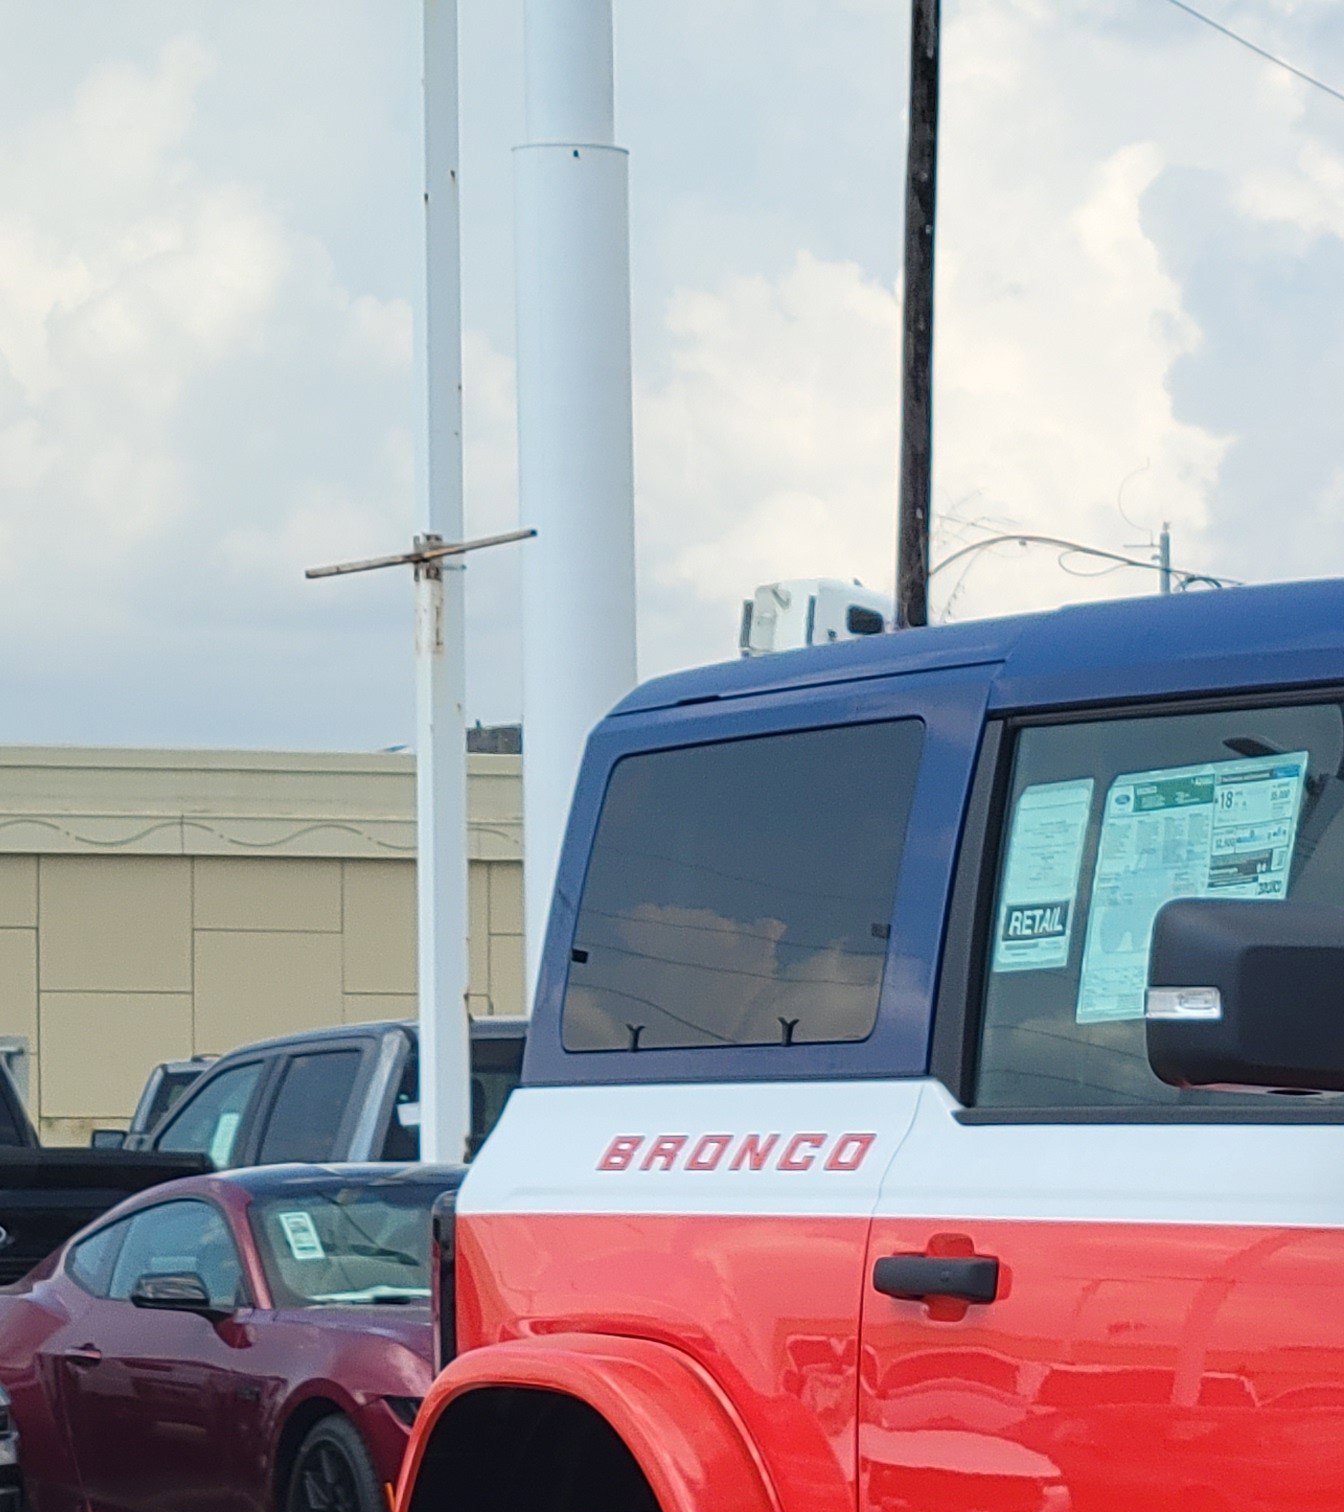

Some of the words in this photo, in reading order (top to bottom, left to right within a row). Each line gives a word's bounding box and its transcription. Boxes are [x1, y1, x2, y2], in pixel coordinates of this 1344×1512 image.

[1219, 790, 1235, 809] 18
[1008, 907, 1063, 936] RETAIL
[596, 1134, 877, 1170] BRONCO
